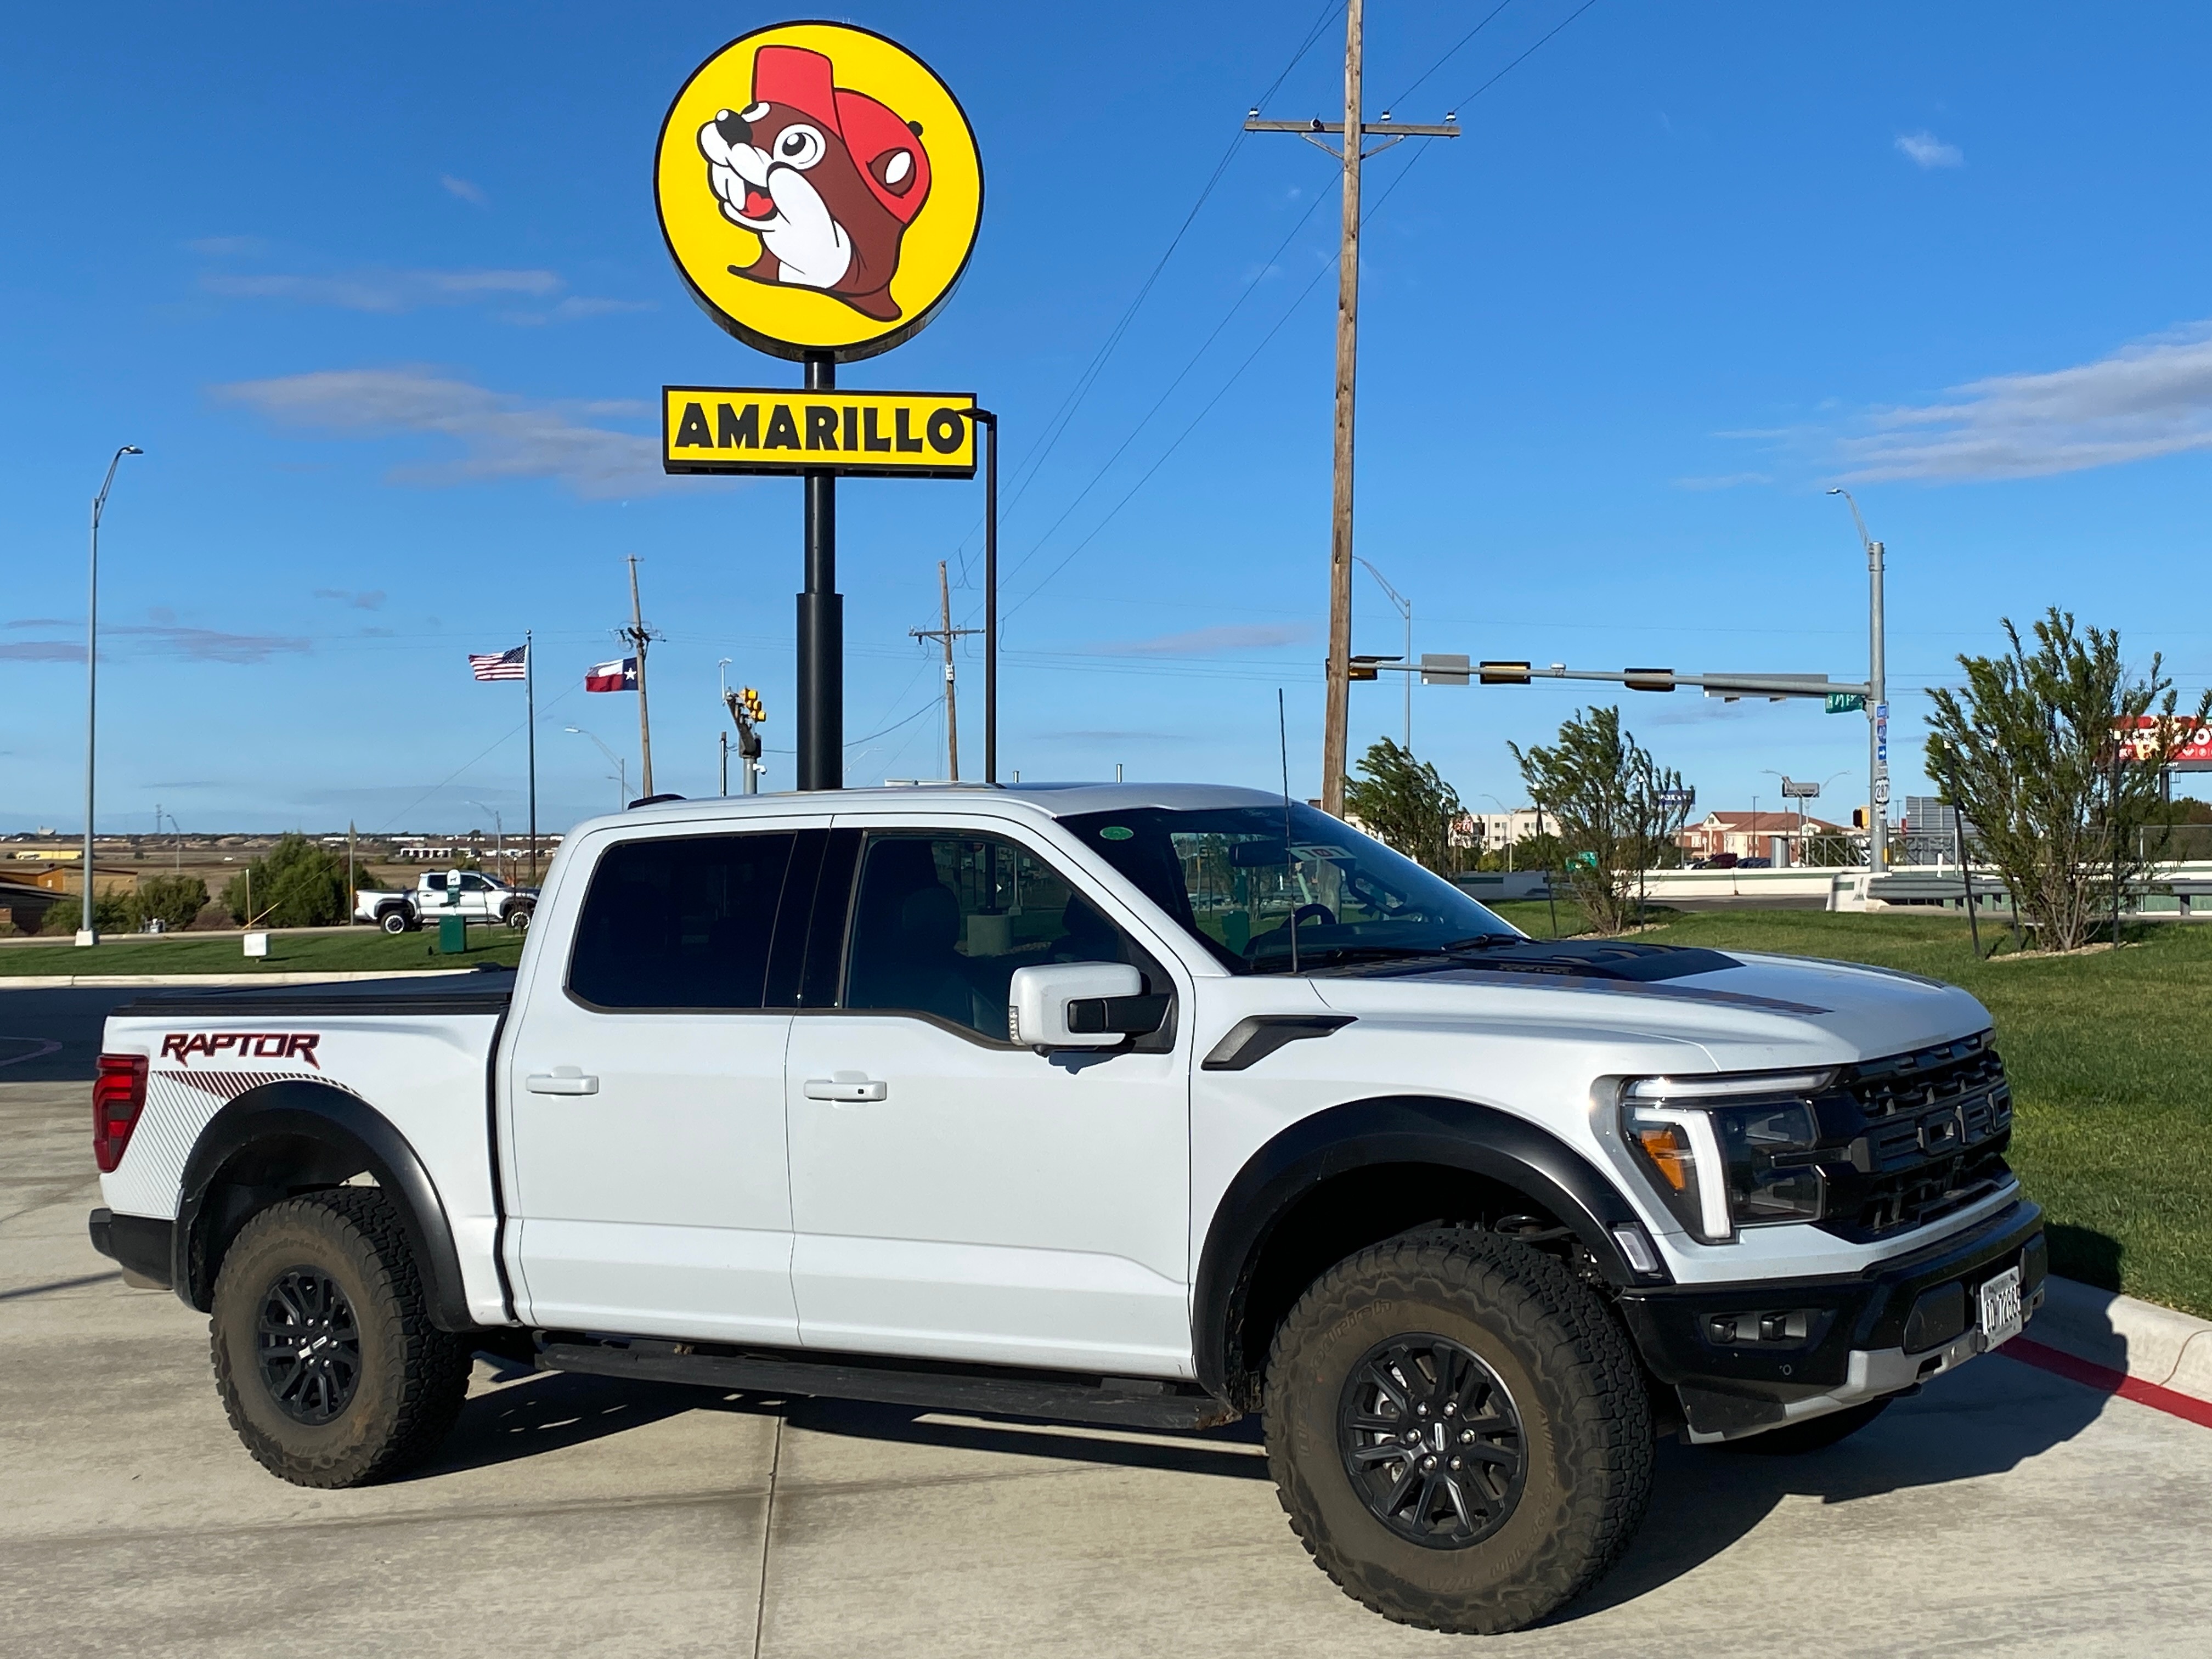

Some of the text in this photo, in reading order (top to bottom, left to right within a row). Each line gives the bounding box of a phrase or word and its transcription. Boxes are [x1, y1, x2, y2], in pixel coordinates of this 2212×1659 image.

[674, 402, 964, 454] AMARILLO
[1877, 784, 1888, 798] 287
[160, 1034, 320, 1070] RAPTOR
[1863, 1083, 2012, 1172] FORD
